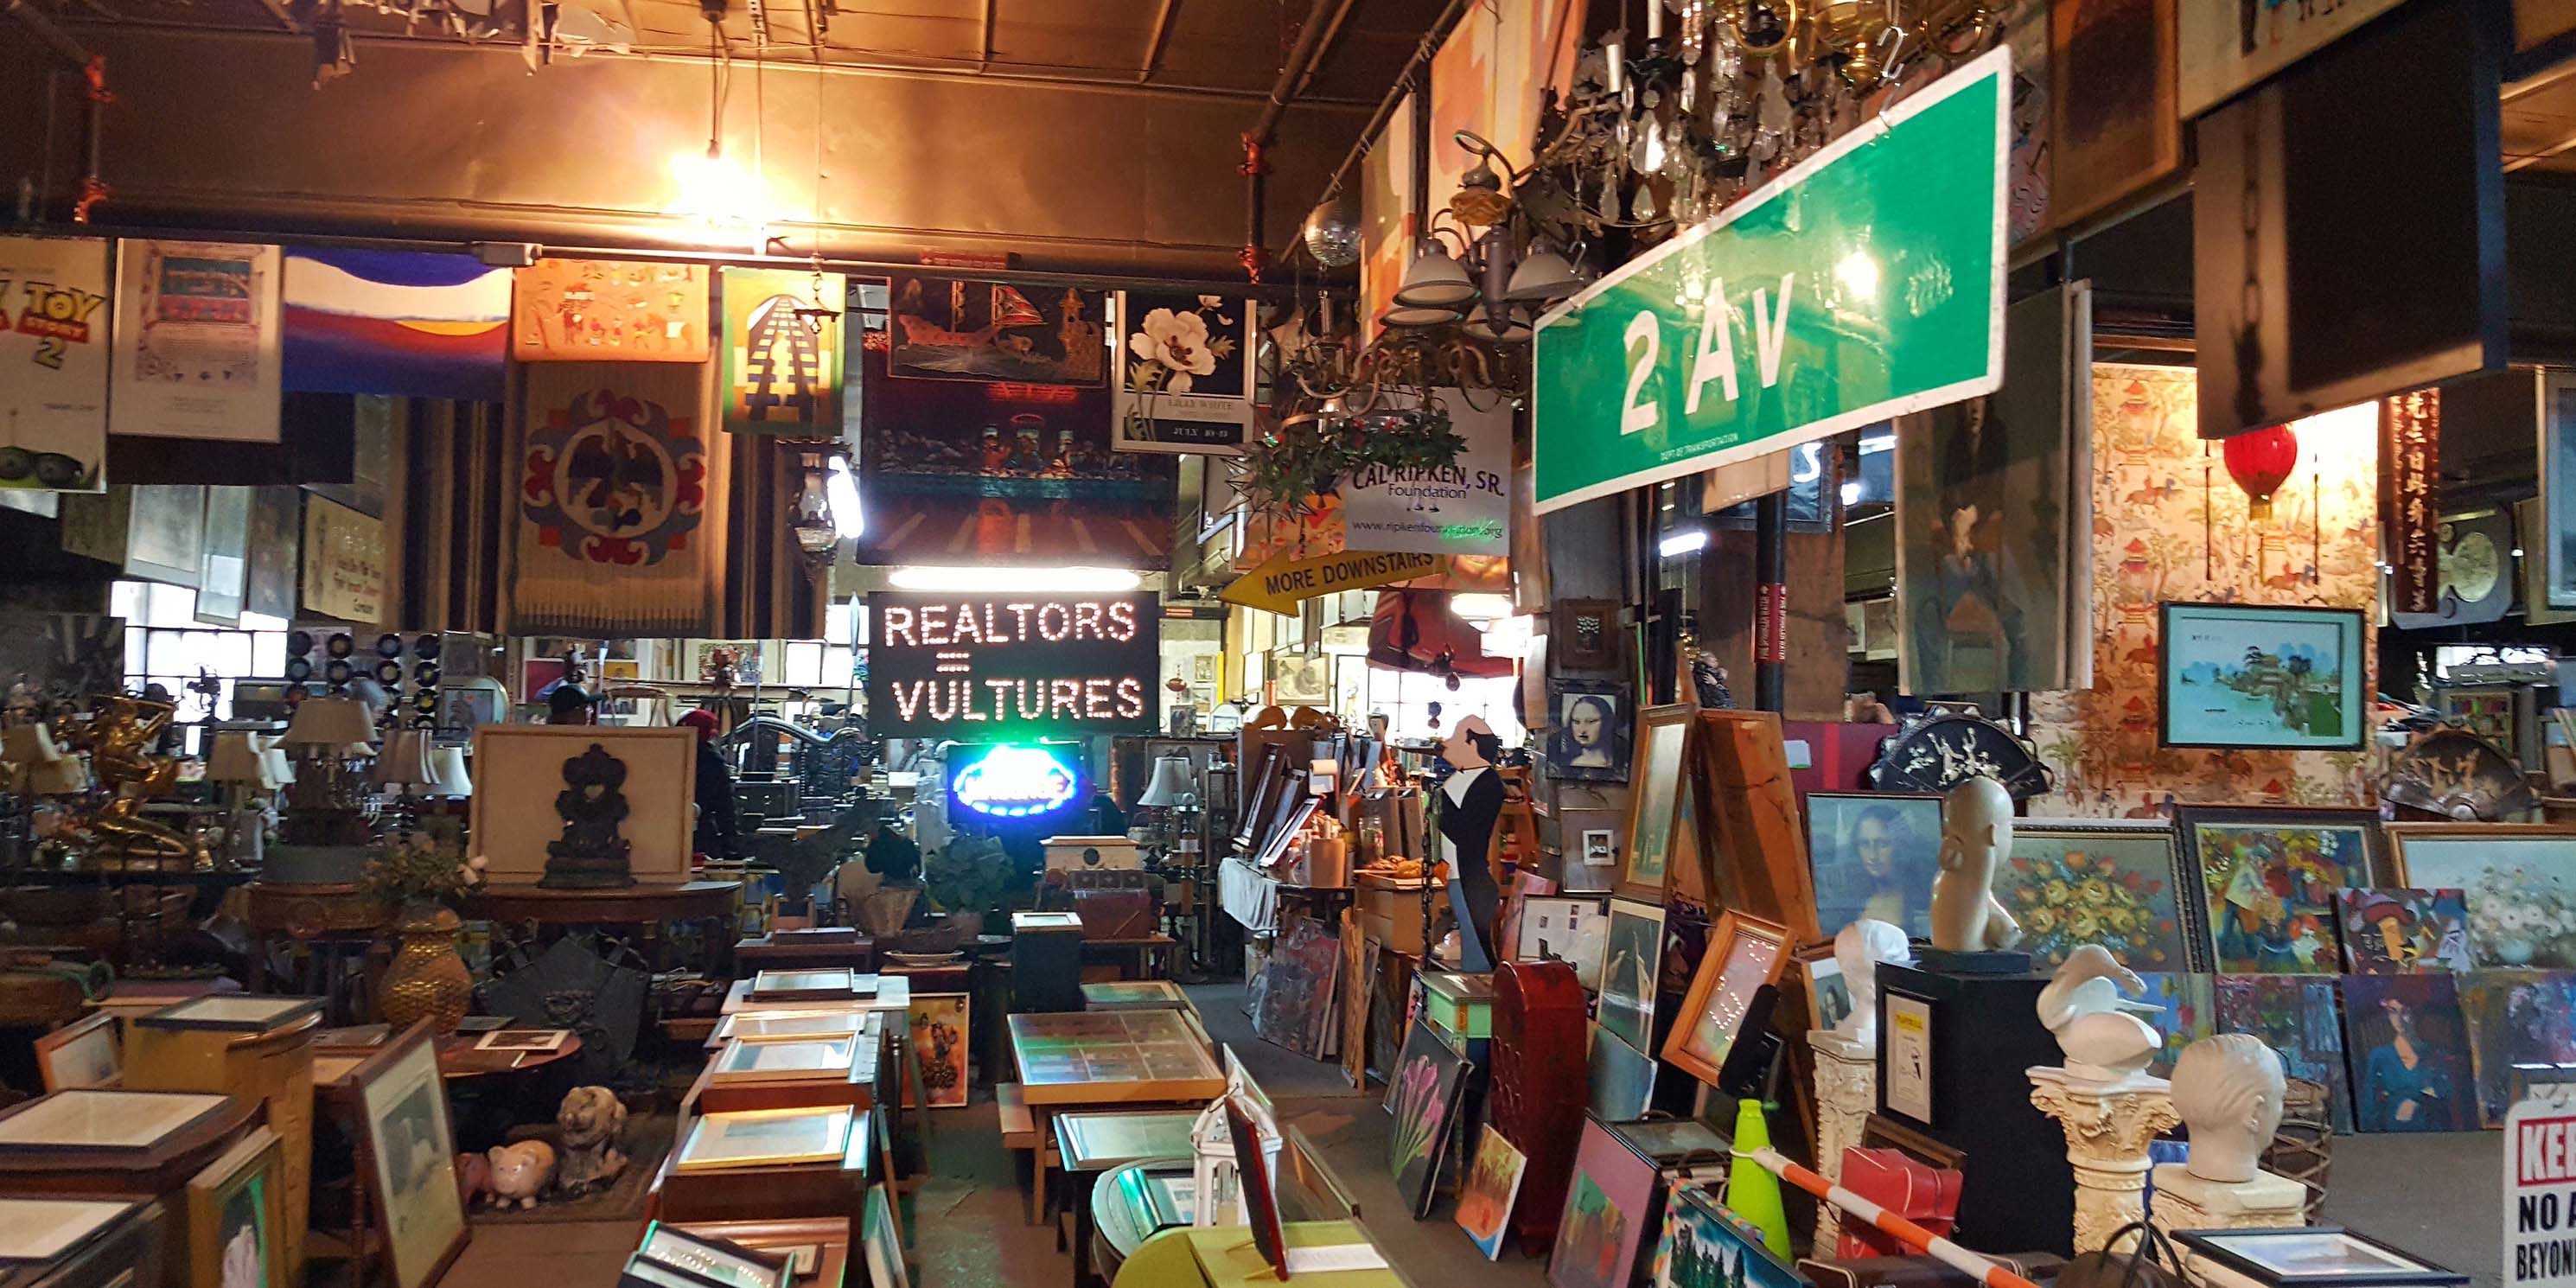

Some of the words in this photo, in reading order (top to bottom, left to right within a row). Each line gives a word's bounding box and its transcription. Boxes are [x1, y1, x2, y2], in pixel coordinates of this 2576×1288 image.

[24, 281, 105, 322] TOY
[32, 335, 67, 371] 2
[1621, 309, 1660, 436] 2
[1685, 272, 1795, 415] AV
[1353, 465, 1388, 490] CAL
[1476, 470, 1505, 497] SR.
[1388, 483, 1466, 499] Foundation
[1266, 569, 1315, 596] MORE
[1323, 552, 1435, 584] DOWNSTAIRS
[885, 602, 1134, 647] REALTORS
[891, 678, 1141, 721] VULTURES
[2519, 1192, 2559, 1234] NO
[2516, 1240, 2576, 1281] BEYON
